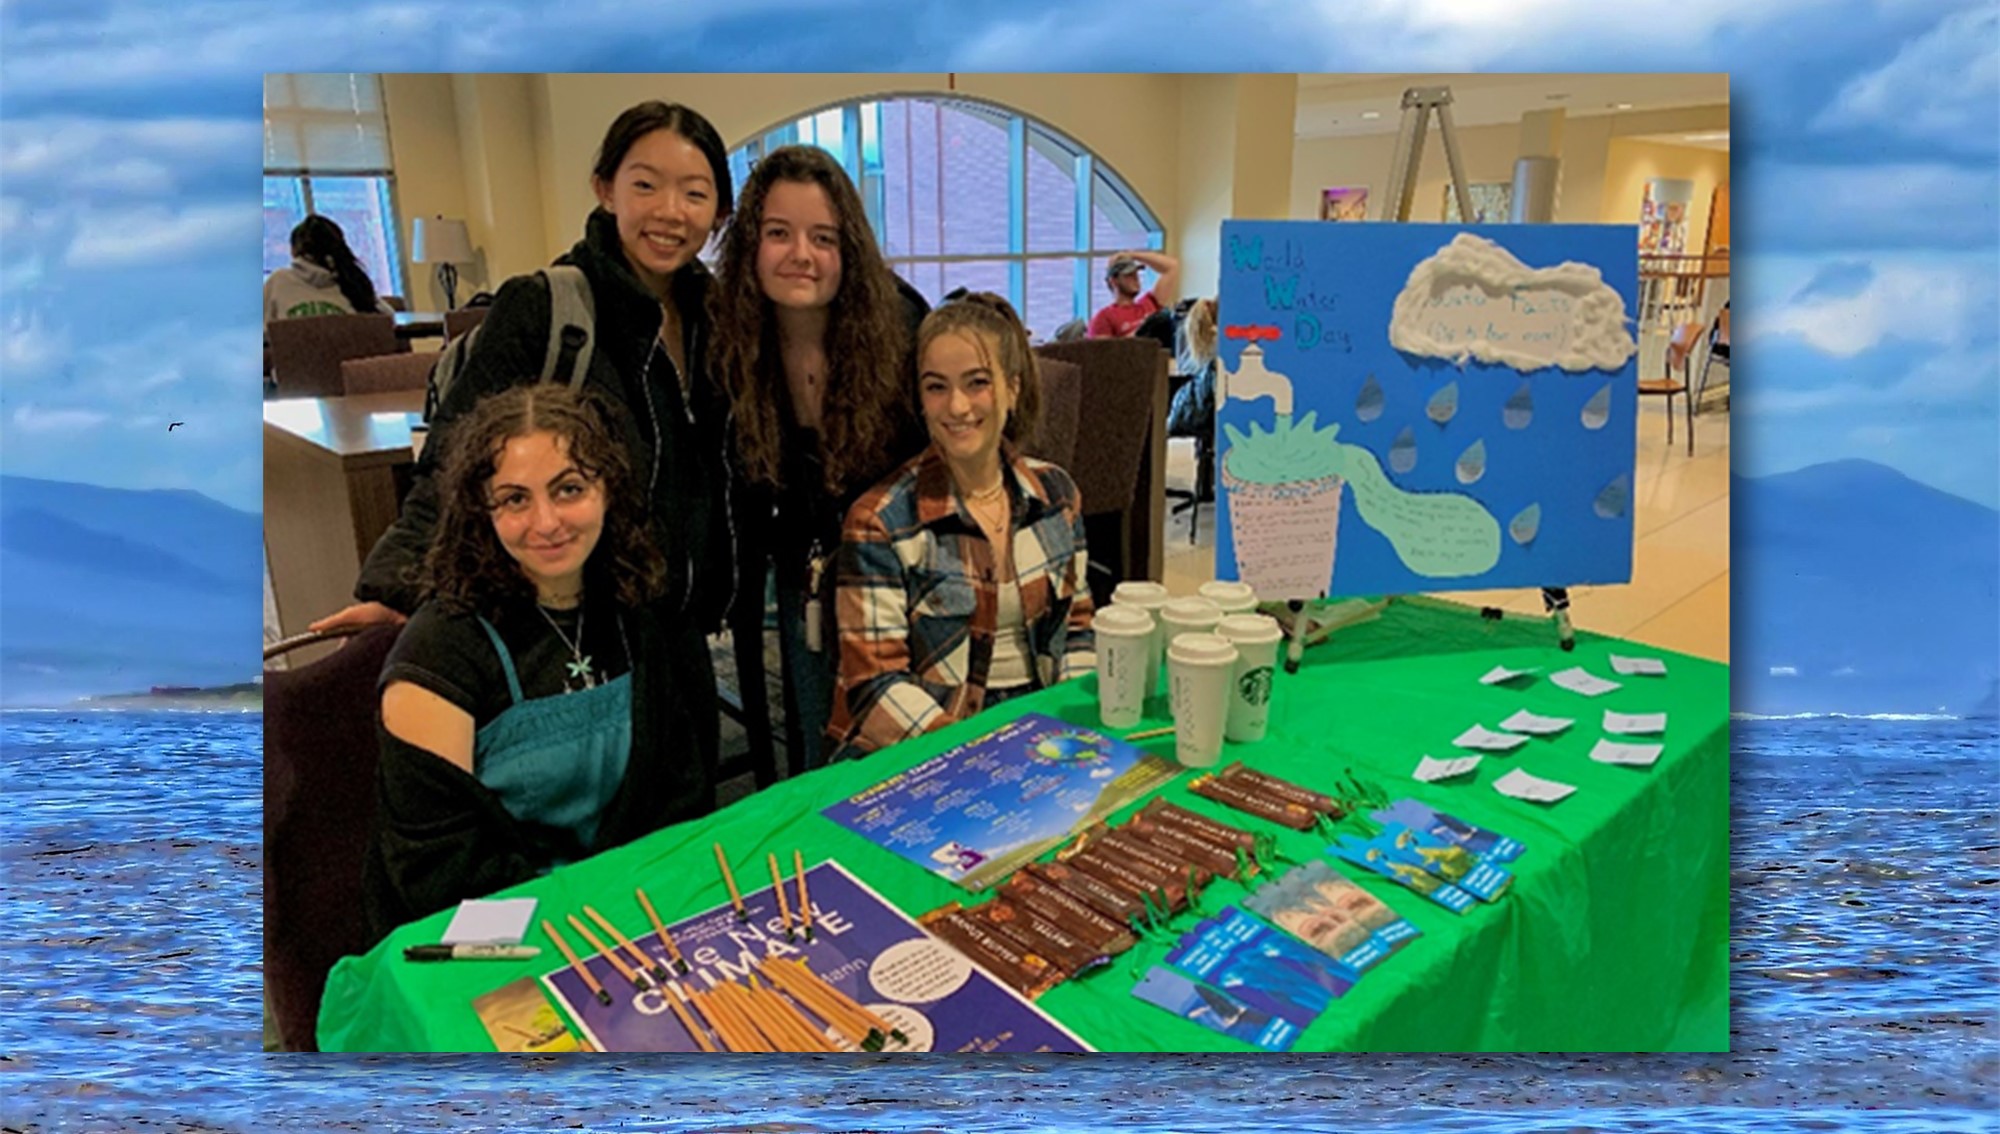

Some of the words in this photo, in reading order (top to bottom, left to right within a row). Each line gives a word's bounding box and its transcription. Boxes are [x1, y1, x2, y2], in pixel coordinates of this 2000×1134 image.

[1230, 234, 1305, 272] World
[1264, 272, 1340, 310] Water
[1295, 312, 1353, 353] Day
[635, 946, 721, 987] The
[727, 902, 822, 952] New
